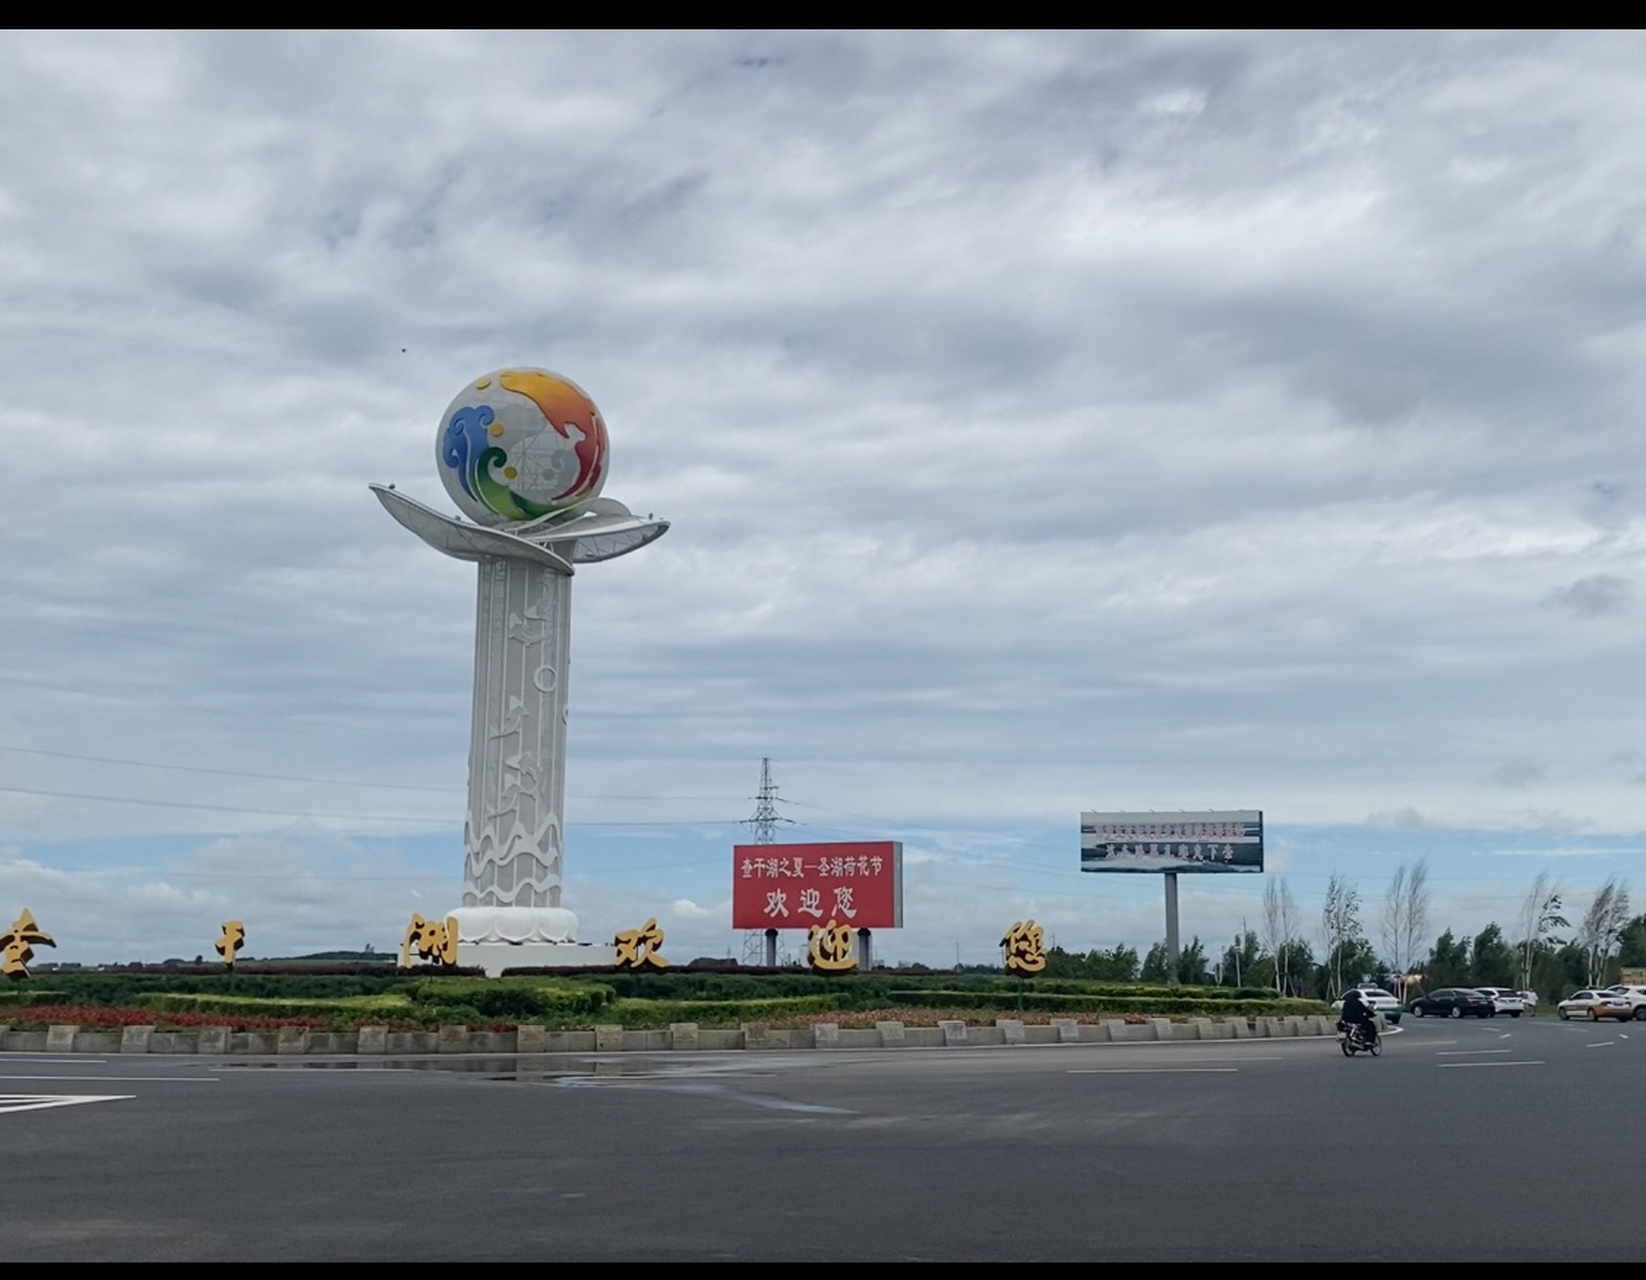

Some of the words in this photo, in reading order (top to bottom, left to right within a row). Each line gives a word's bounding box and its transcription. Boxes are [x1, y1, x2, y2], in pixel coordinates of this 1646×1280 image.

[763, 886, 857, 918] 欢迎您
[614, 917, 670, 970] 欢
[808, 919, 859, 972] 迎
[1001, 919, 1047, 974] 您
